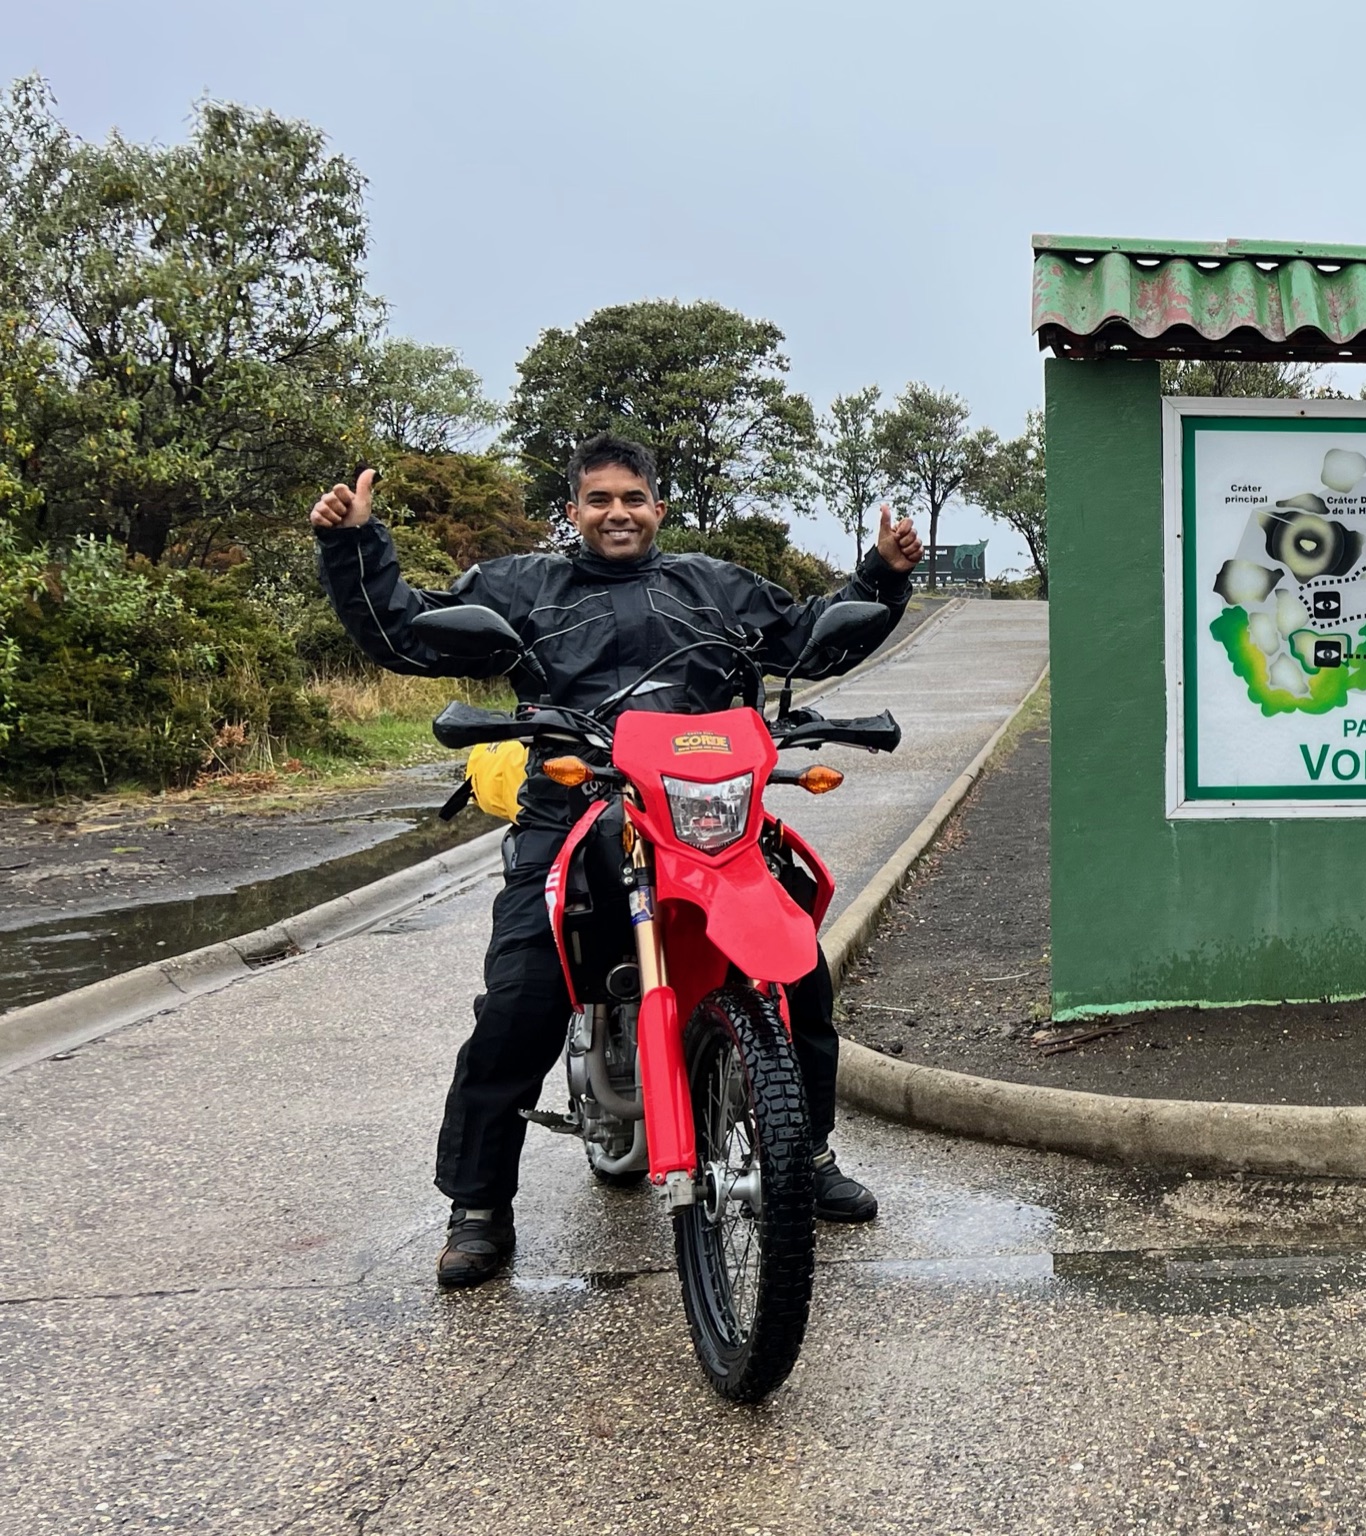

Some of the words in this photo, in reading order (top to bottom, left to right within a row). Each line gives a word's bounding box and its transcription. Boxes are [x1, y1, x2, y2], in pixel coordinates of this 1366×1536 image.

[1230, 484, 1262, 493] Cráter
[1224, 495, 1268, 505] principal
[1326, 496, 1357, 505] Cráter
[1331, 507, 1344, 516] de
[1346, 507, 1356, 516] la
